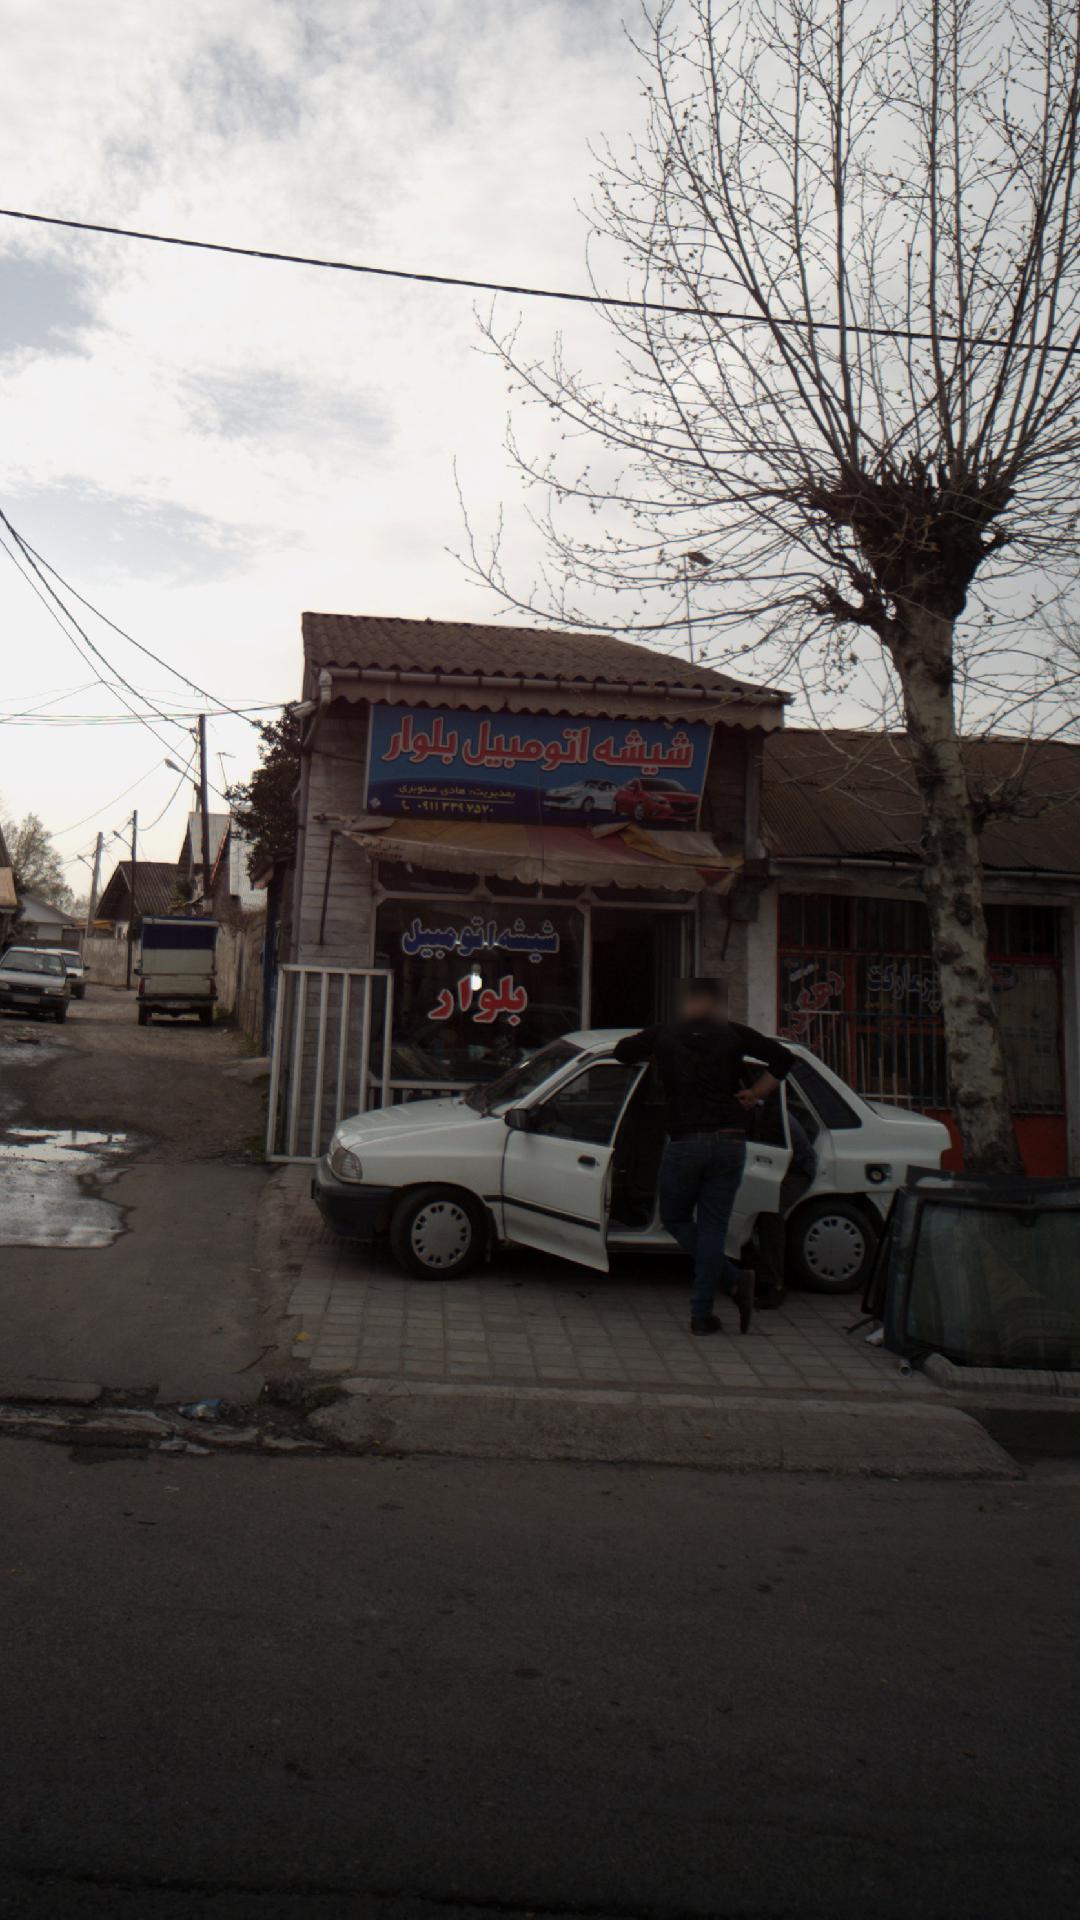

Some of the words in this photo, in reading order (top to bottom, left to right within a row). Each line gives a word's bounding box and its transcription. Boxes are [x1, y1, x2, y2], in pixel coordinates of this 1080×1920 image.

[382, 714, 458, 766] بلوار
[463, 719, 591, 771] اتومبیل
[594, 728, 695, 775] شیشه
[401, 916, 498, 960] اتومبیل
[498, 917, 560, 964] شیشه
[428, 975, 528, 1026] بلوار
